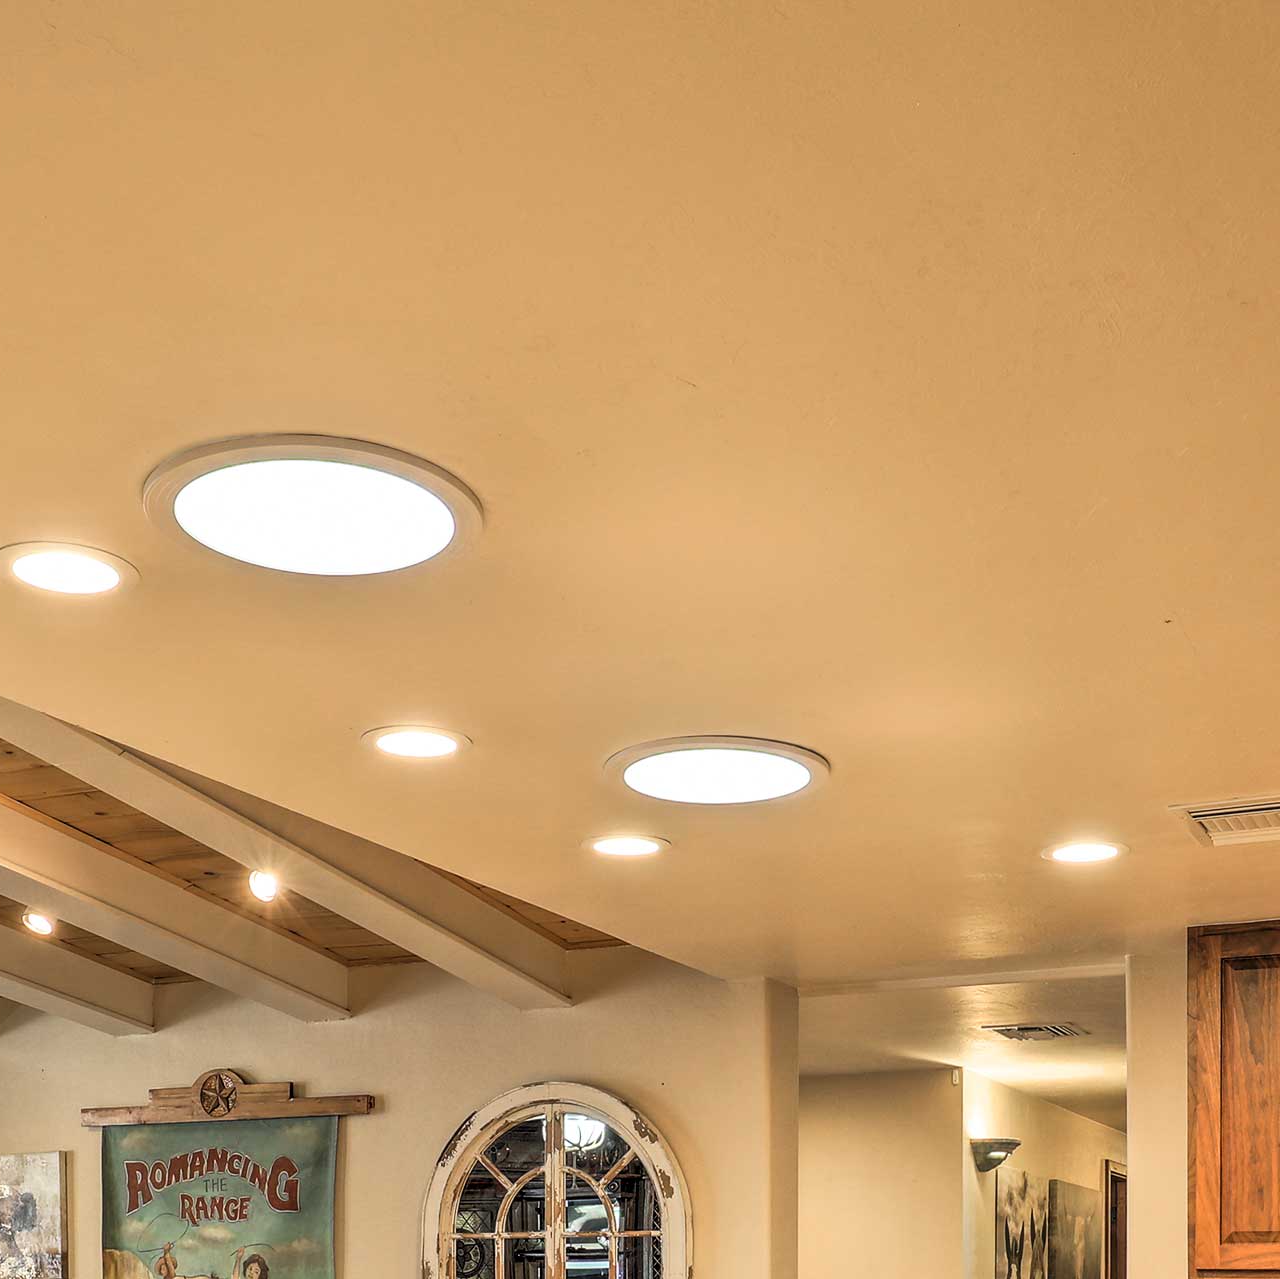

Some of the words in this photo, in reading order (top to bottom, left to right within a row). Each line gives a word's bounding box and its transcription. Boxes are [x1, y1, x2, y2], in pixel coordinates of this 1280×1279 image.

[124, 1148, 301, 1216] ROMANCING
[203, 1178, 228, 1193] THE
[179, 1193, 252, 1226] RANGE
